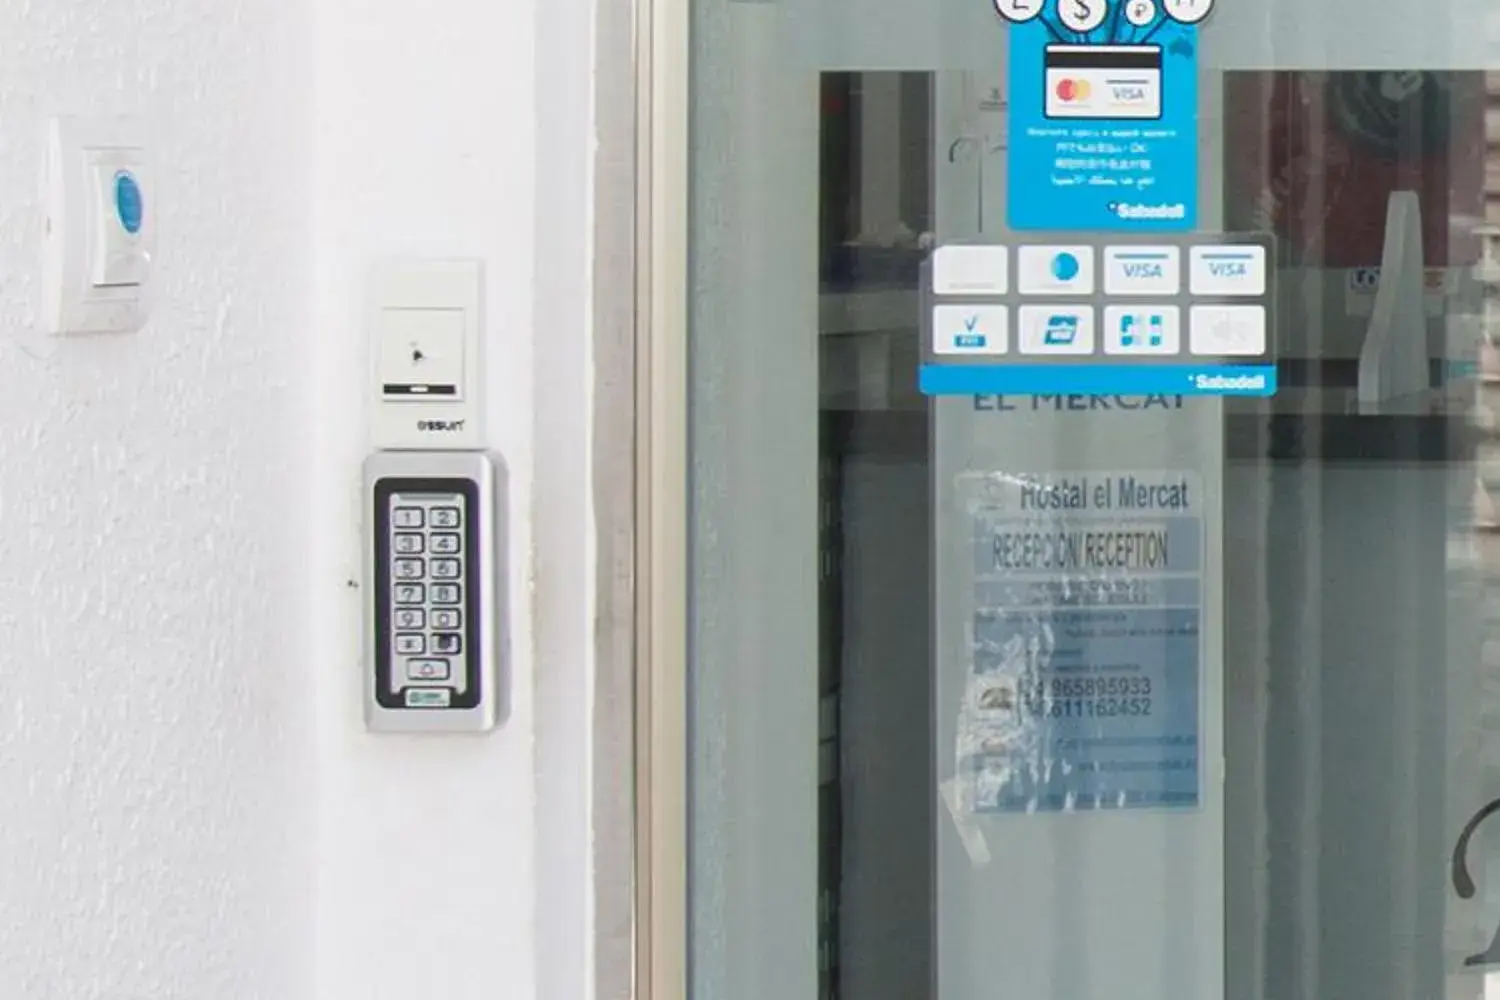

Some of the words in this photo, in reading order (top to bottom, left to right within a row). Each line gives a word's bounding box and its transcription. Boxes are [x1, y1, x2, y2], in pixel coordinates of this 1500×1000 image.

[1111, 88, 1146, 101] VISA
[1122, 263, 1163, 278] VISA
[1208, 263, 1247, 278] VISA
[973, 392, 1016, 412] EL
[1031, 392, 1184, 413] MERCAT
[1020, 477, 1087, 511] Hostal
[1095, 477, 1112, 509] el
[1118, 476, 1189, 511] Mercat
[1085, 531, 1168, 569] RECEPTION
